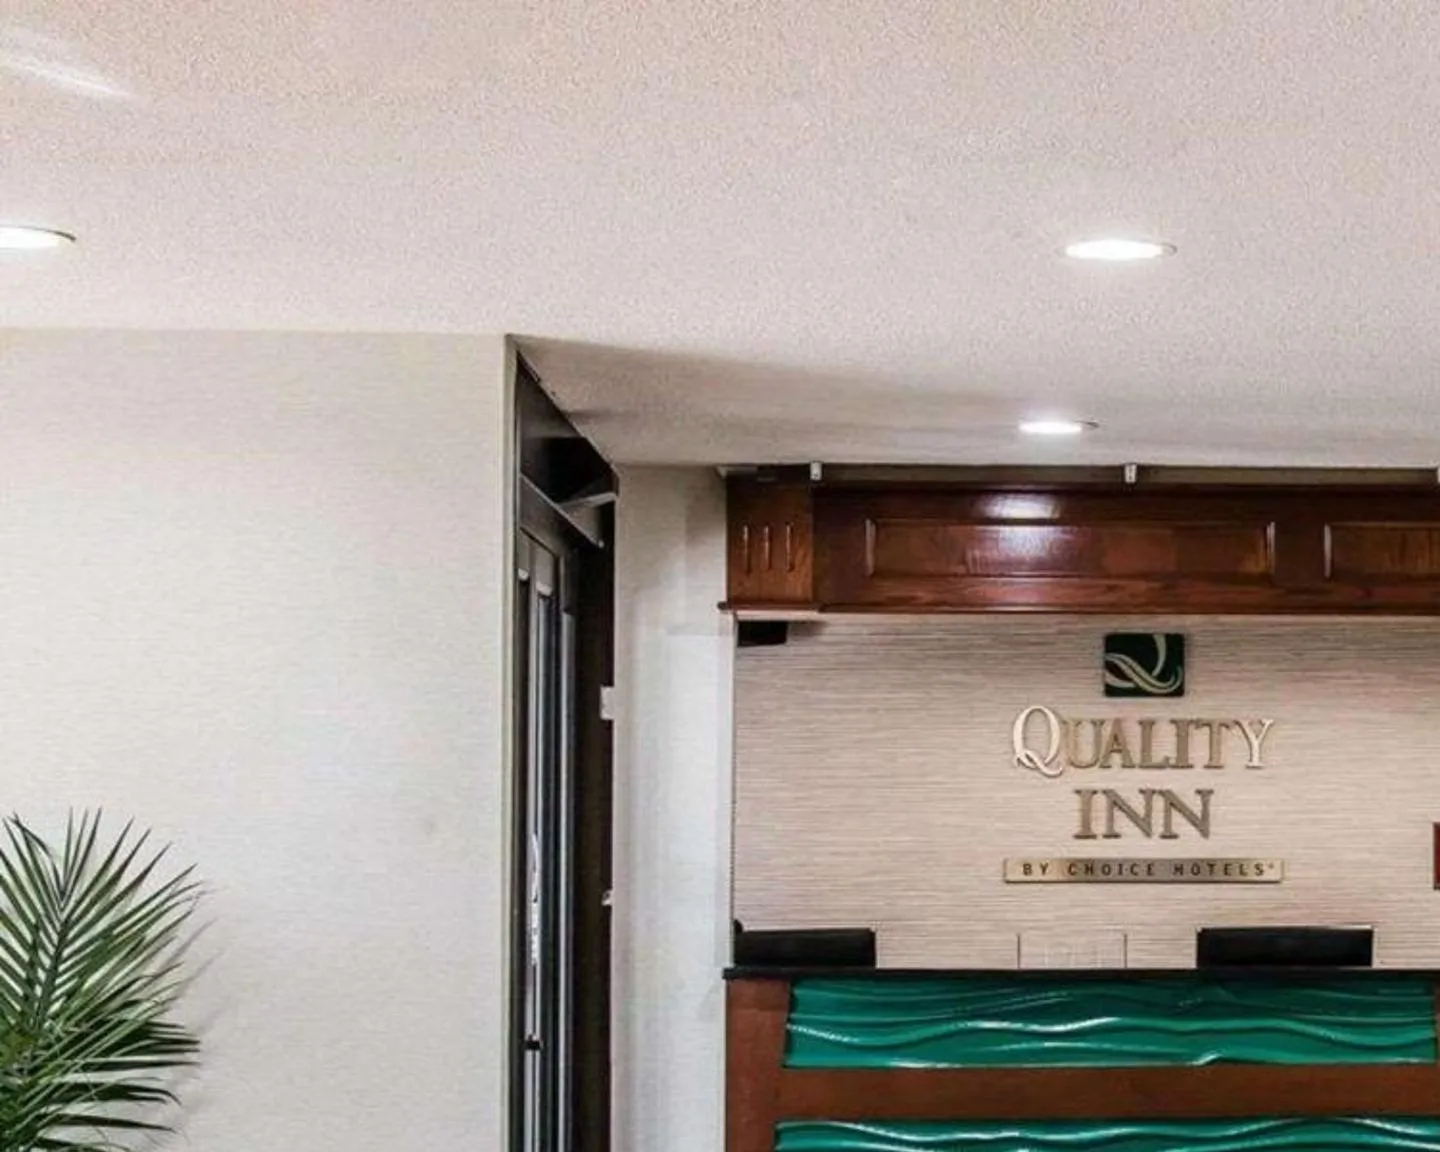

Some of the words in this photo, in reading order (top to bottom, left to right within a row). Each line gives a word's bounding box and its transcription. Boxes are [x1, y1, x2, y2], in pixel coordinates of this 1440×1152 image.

[1013, 705, 1274, 778] QUALITY
[1073, 788, 1215, 839] INN
[1022, 862, 1049, 876] BY
[1067, 862, 1154, 876] CHOICE
